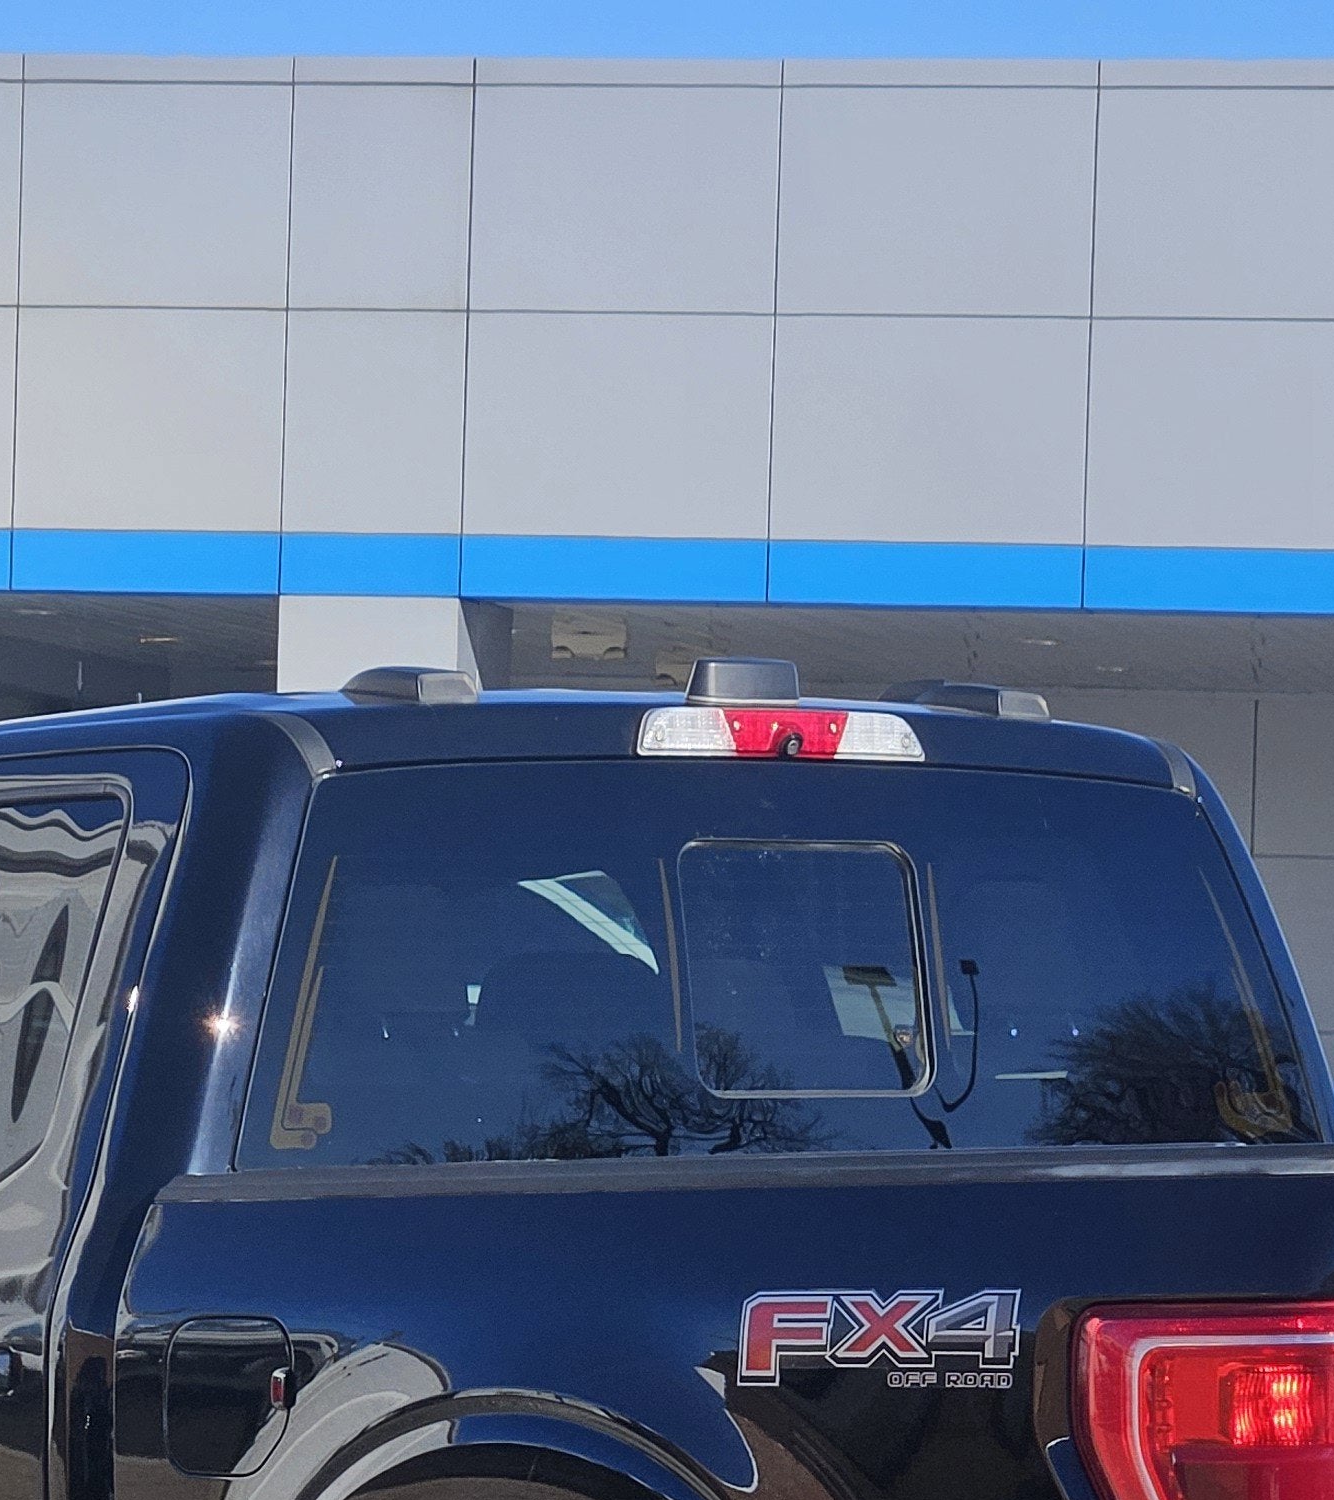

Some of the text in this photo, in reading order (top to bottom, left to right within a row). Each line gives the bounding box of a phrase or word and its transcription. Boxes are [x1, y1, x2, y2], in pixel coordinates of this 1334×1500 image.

[737, 1288, 1021, 1387] FX4
[887, 1371, 1013, 1389] OFF ROAD
